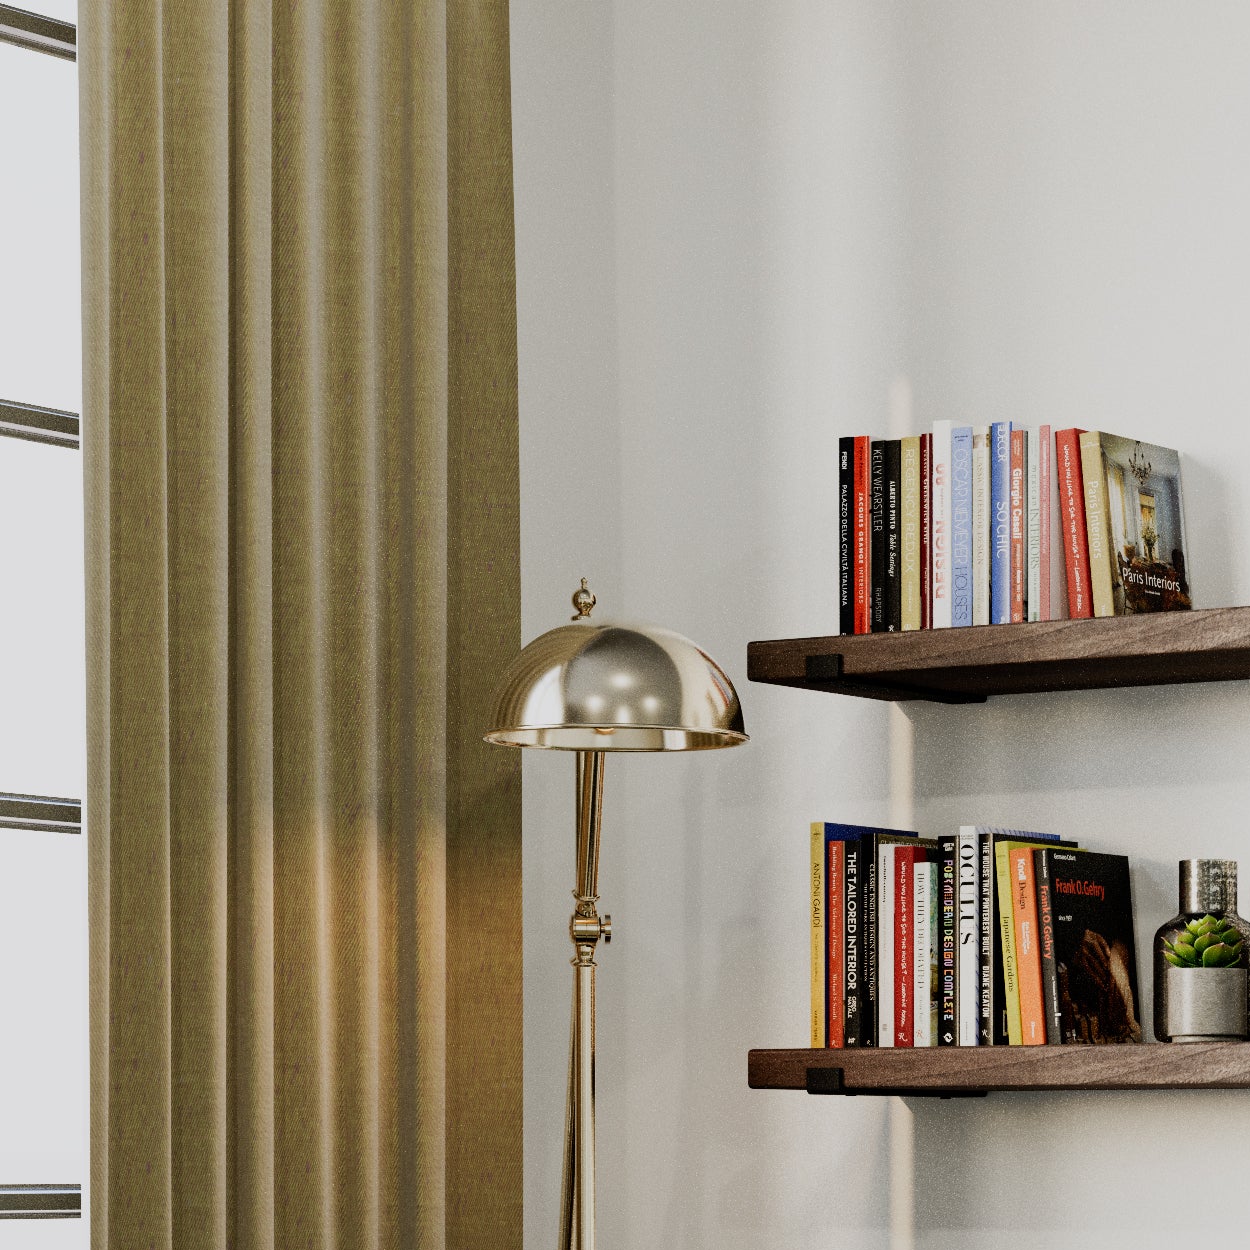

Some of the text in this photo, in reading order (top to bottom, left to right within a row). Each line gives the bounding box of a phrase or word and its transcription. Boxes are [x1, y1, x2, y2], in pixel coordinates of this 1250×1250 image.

[873, 449, 883, 532] KELLY WEARSTLER
[906, 448, 915, 518] REGENCY
[1011, 468, 1022, 506] Giorgio
[1063, 444, 1071, 467] WOULD
[1068, 496, 1074, 506] TO
[889, 533, 897, 551] Table
[954, 448, 968, 620] OSCAR NIEMEYER HOUSES
[997, 502, 1007, 559] SO CHIC
[1012, 508, 1021, 539] Casali
[1030, 508, 1040, 570] INTERIORS
[1087, 481, 1104, 559] Paris Interiors
[888, 551, 897, 577] Settings
[906, 522, 915, 572] REDUX
[936, 520, 945, 599] DESIGN
[1122, 567, 1181, 592] Paris Interiors
[917, 873, 925, 896] HOW
[960, 844, 974, 945] OCULUS
[1017, 858, 1026, 880] Knoll
[1055, 878, 1076, 894] Frank
[813, 899, 823, 928] GAUDÍ
[847, 852, 857, 990] THE TAILORED INTERIOR
[917, 899, 925, 924] THEY
[1018, 881, 1026, 910] Design
[1040, 885, 1050, 914] Frank
[943, 929, 954, 967] DESIGN
[982, 842, 990, 1018] THE HOUSE THAT PINTEREST BUILT DIANE KEATON
[1002, 916, 1015, 992] Japanese Gardens
[917, 928, 925, 989] DECORATED
[943, 969, 954, 1021] COMPLETE
